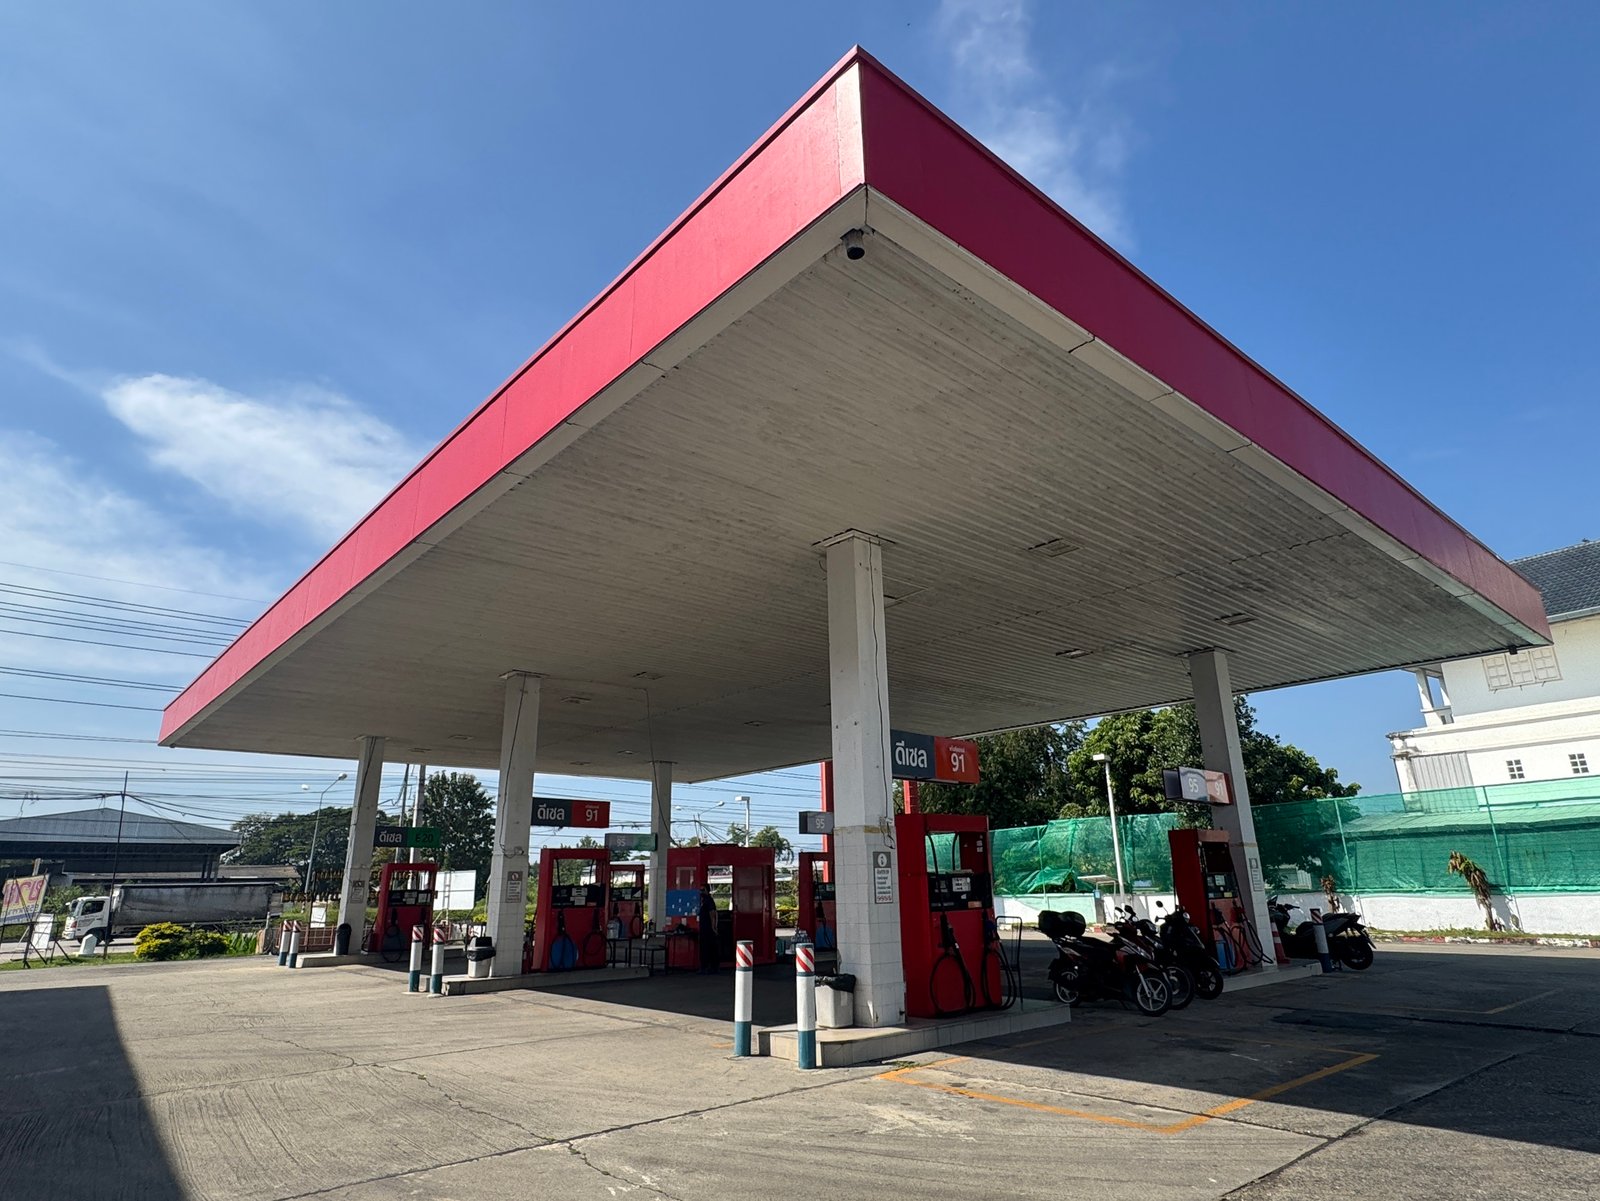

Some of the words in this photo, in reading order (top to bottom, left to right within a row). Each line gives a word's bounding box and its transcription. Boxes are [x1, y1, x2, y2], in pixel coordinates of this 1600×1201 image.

[895, 740, 928, 769] ดีเซล
[950, 752, 966, 773] 91
[1188, 777, 1199, 793] 95
[537, 803, 565, 820] ดีเซล
[585, 809, 598, 822] 91
[815, 818, 825, 829] 95
[379, 830, 402, 843] ดีเซล
